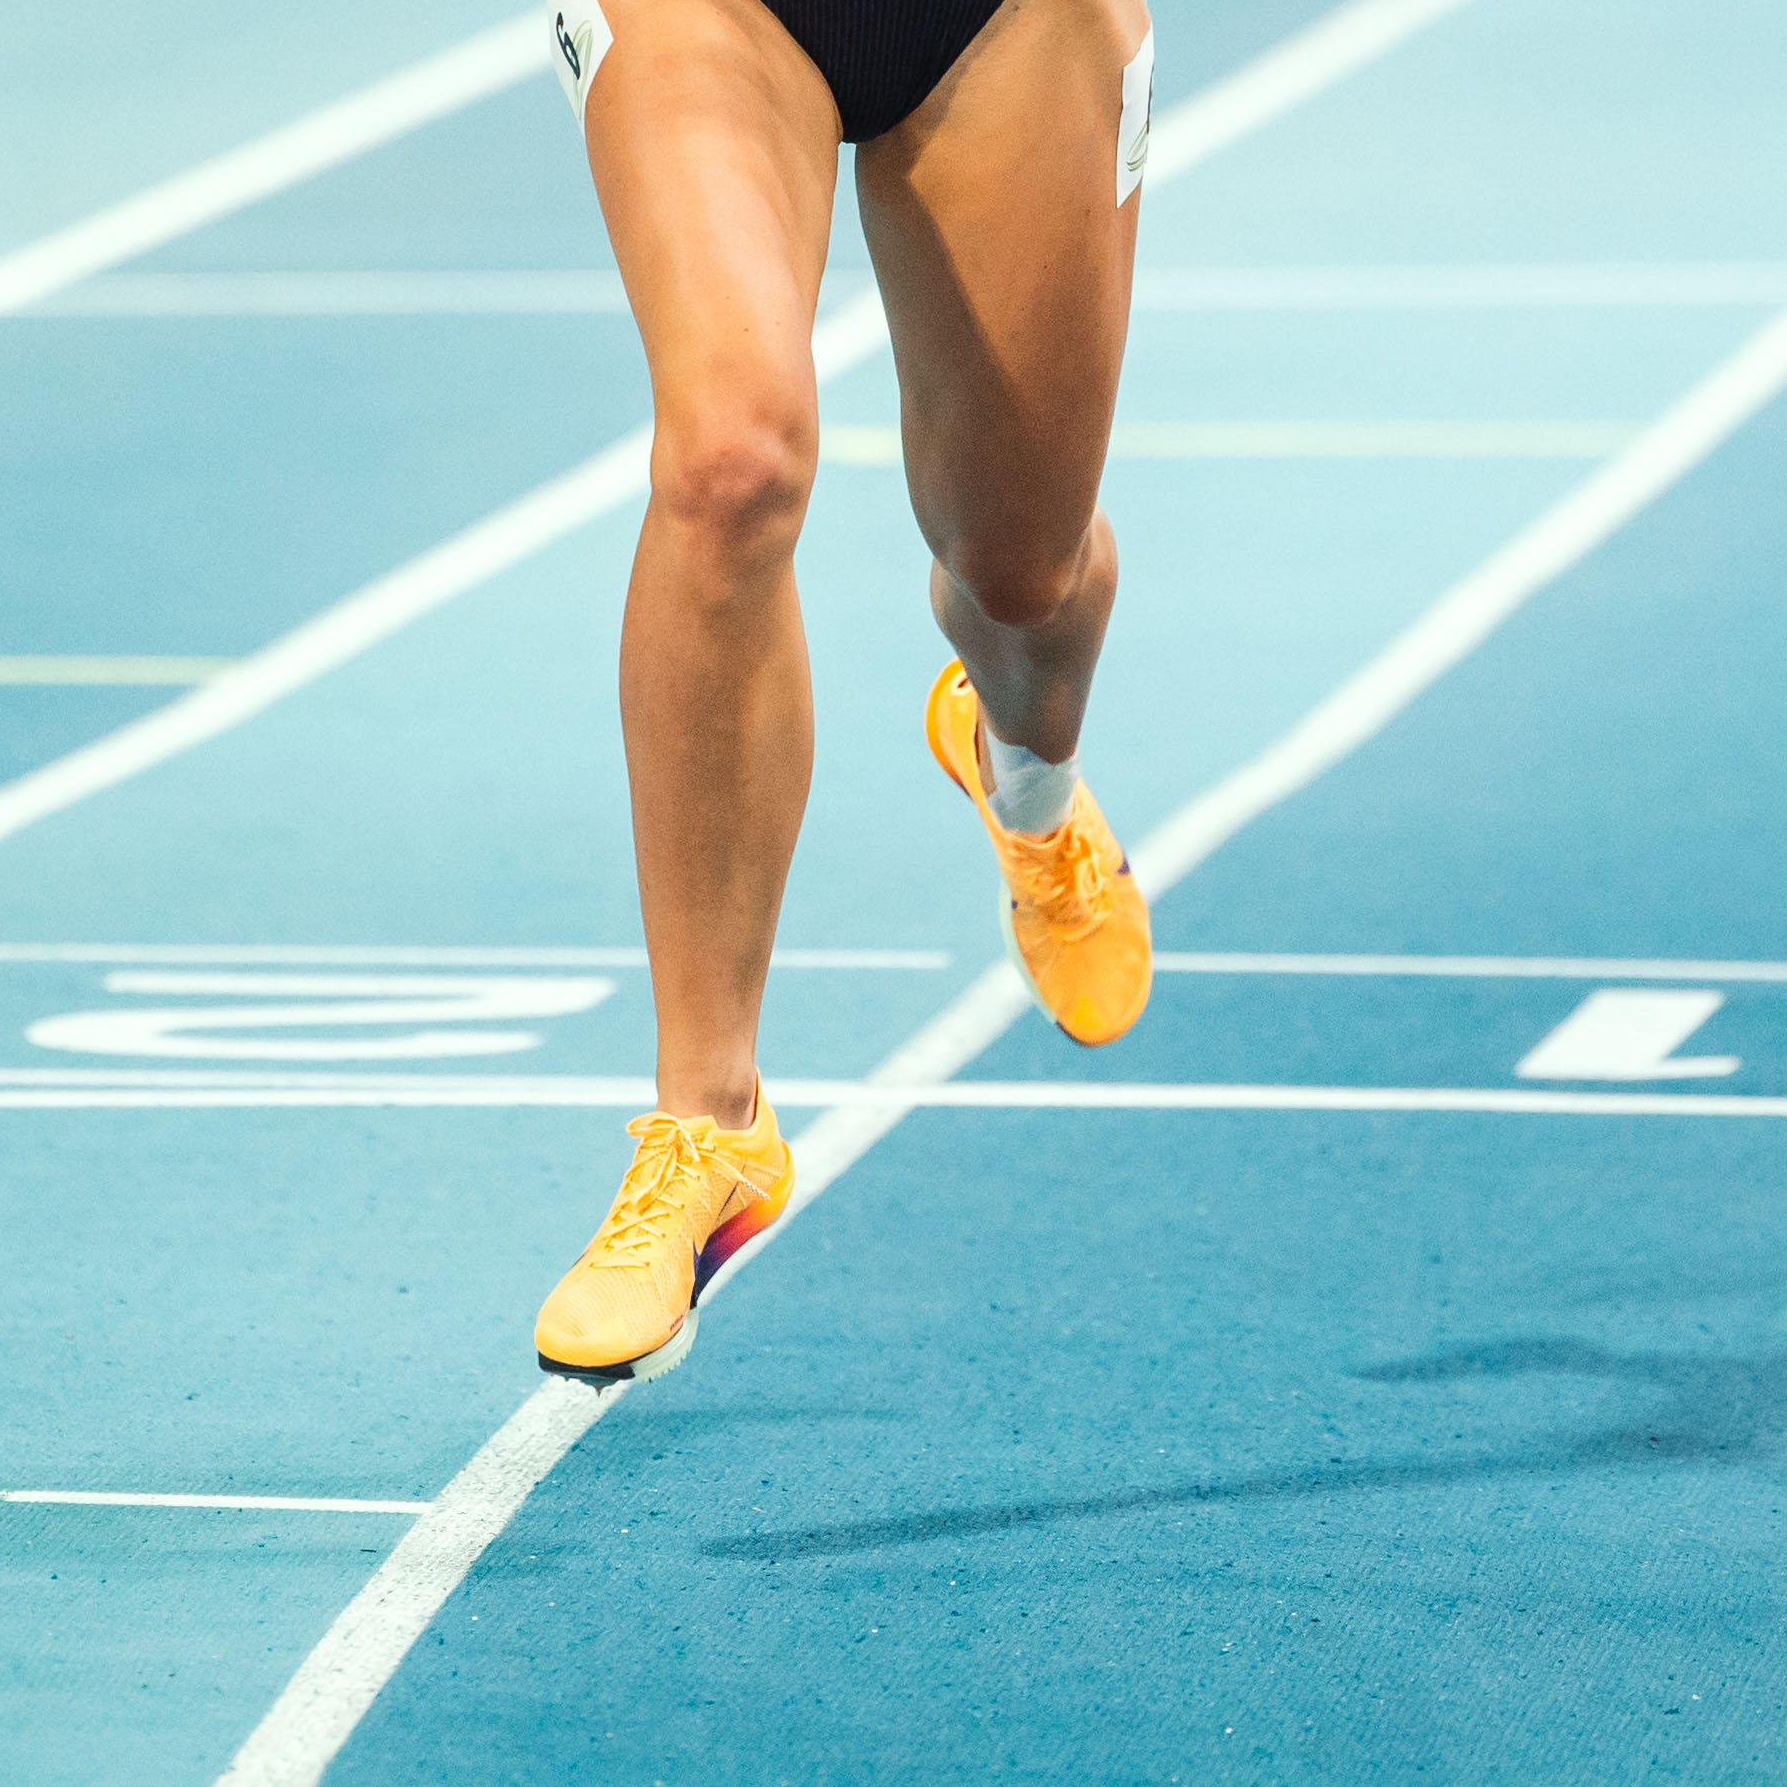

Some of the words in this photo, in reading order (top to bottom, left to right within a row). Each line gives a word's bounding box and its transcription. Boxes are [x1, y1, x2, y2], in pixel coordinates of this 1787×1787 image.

[556, 11, 581, 80] 6
[24, 970, 616, 1060] 2
[1515, 988, 1742, 1080] 1
